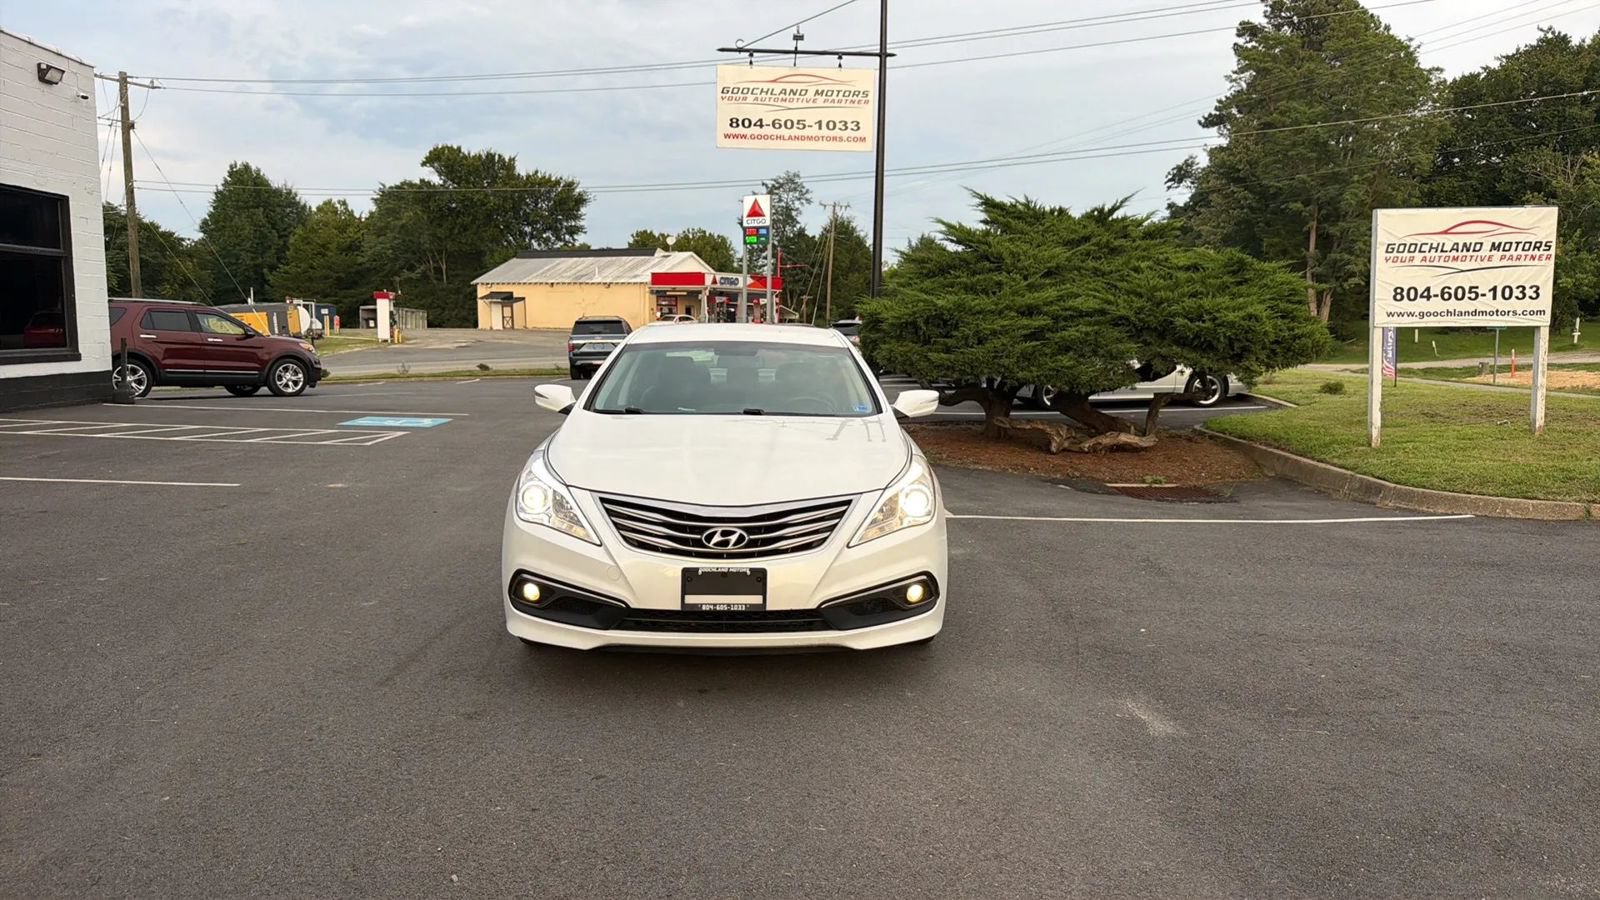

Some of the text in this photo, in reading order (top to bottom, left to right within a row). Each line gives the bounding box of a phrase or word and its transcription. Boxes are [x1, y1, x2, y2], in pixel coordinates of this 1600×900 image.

[721, 86, 870, 98] GOOCHLAND MOTORS
[729, 118, 861, 132] 804-605-1033
[724, 132, 866, 143] WWW.GOOCHLANDMOTORS.COM
[1384, 240, 1552, 254] GOOCHLAND MOTORS
[1384, 254, 1552, 264] YOUR AUTOMOTIVE PARTNER
[720, 277, 739, 286] CITGO
[1392, 286, 1540, 302] 804-605-1033
[1386, 308, 1546, 319] www.goochlandmotors.com
